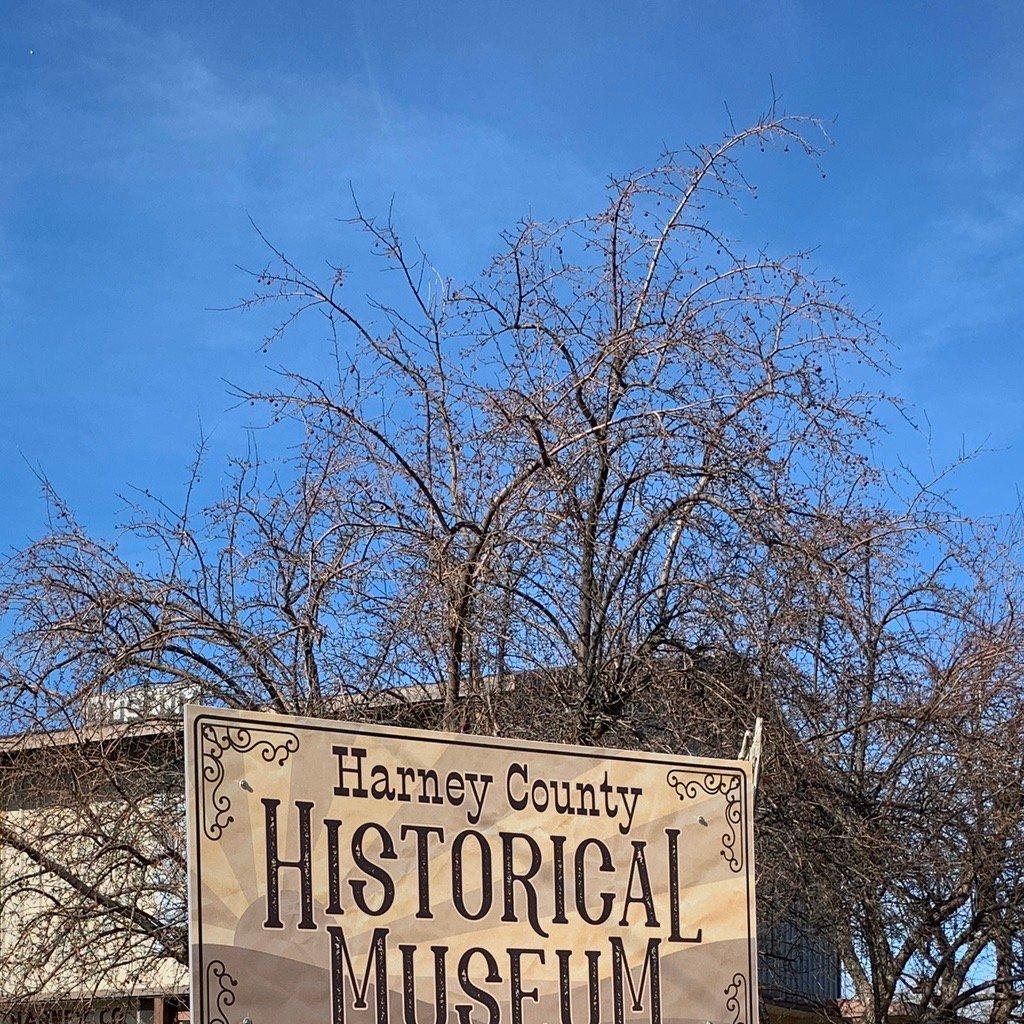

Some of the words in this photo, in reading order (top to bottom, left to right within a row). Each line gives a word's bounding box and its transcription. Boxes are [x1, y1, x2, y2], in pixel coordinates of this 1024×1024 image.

[332, 745, 493, 825] Harney
[507, 762, 643, 834] County
[261, 798, 703, 943] HISTORICAL
